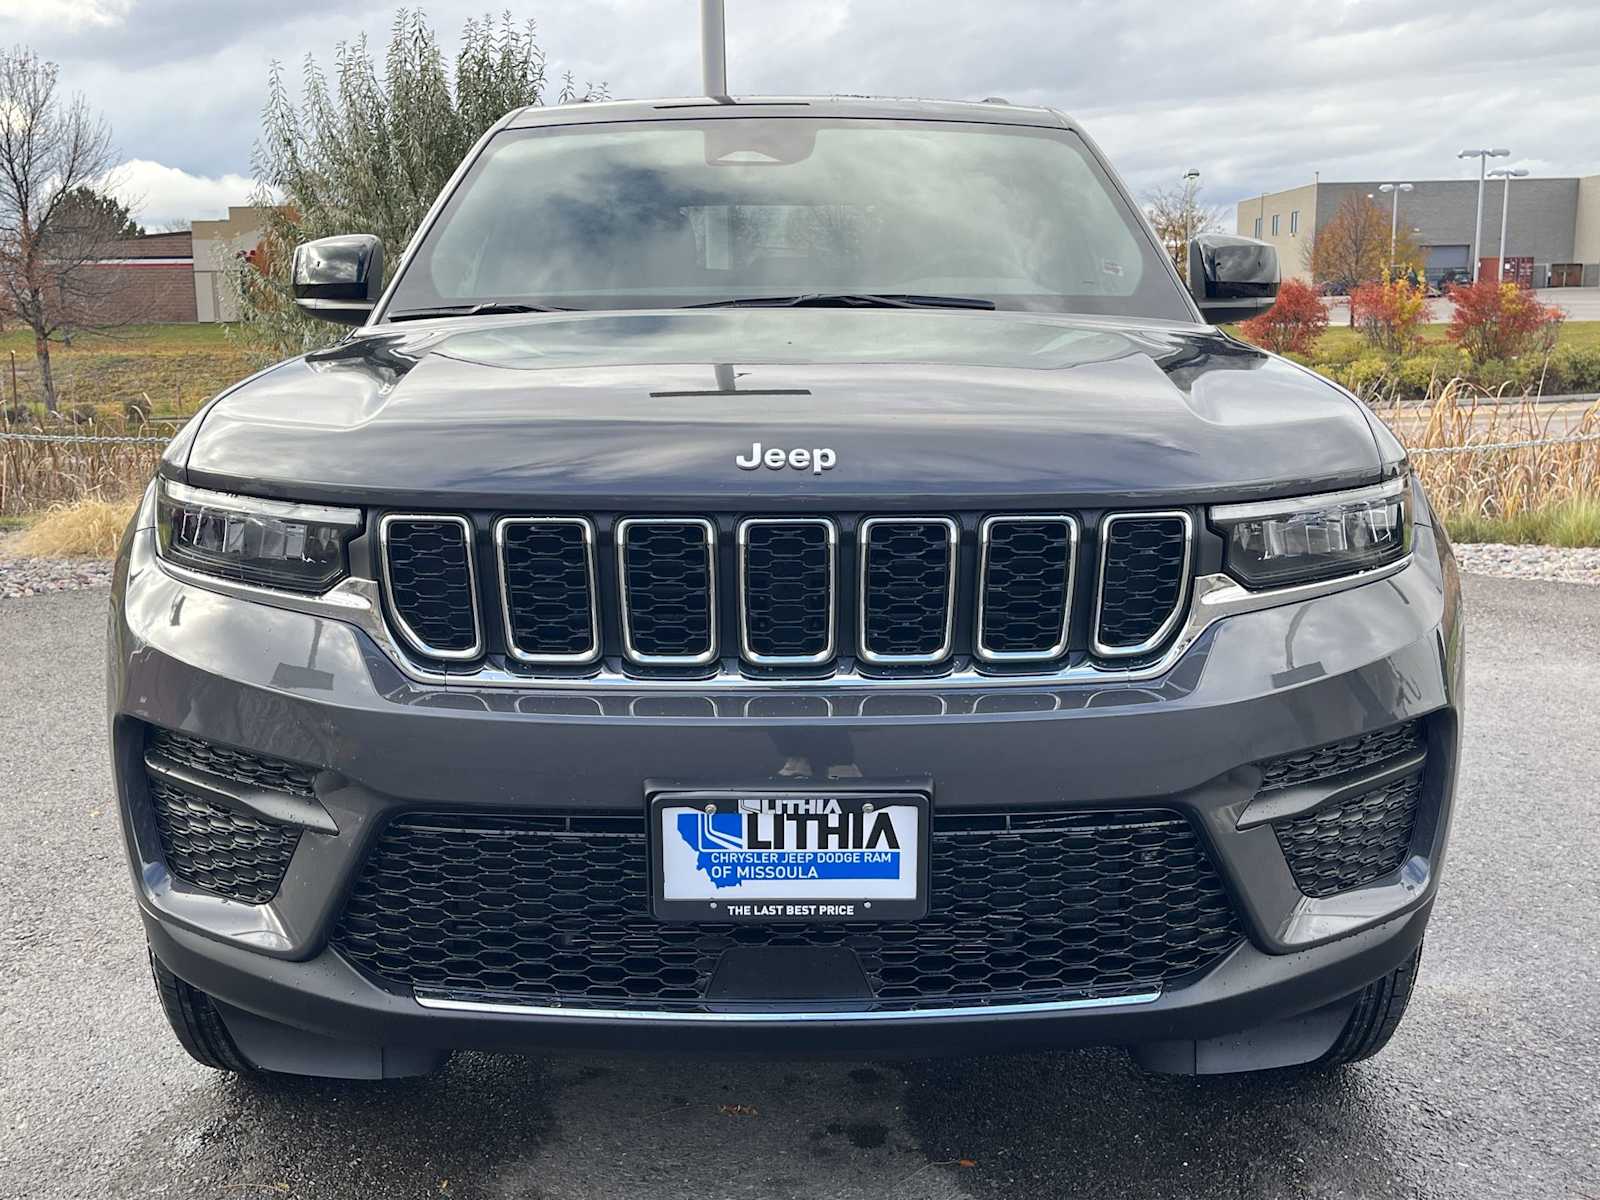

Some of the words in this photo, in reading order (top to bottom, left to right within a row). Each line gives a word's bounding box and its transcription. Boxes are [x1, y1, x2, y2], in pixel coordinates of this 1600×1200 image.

[736, 443, 836, 475] Jeep
[761, 800, 842, 815] LITHIA
[747, 812, 900, 850] LITHIA
[711, 852, 778, 864] CHRYSLER
[782, 853, 814, 865] JEEP
[817, 853, 861, 864] DODGE
[864, 853, 891, 863] RAM
[711, 866, 732, 879] OF
[737, 866, 818, 879] MISSOULA
[728, 906, 750, 916] THE
[754, 906, 783, 916] LAST
[786, 906, 816, 916] BEST
[820, 906, 854, 916] PRICE
